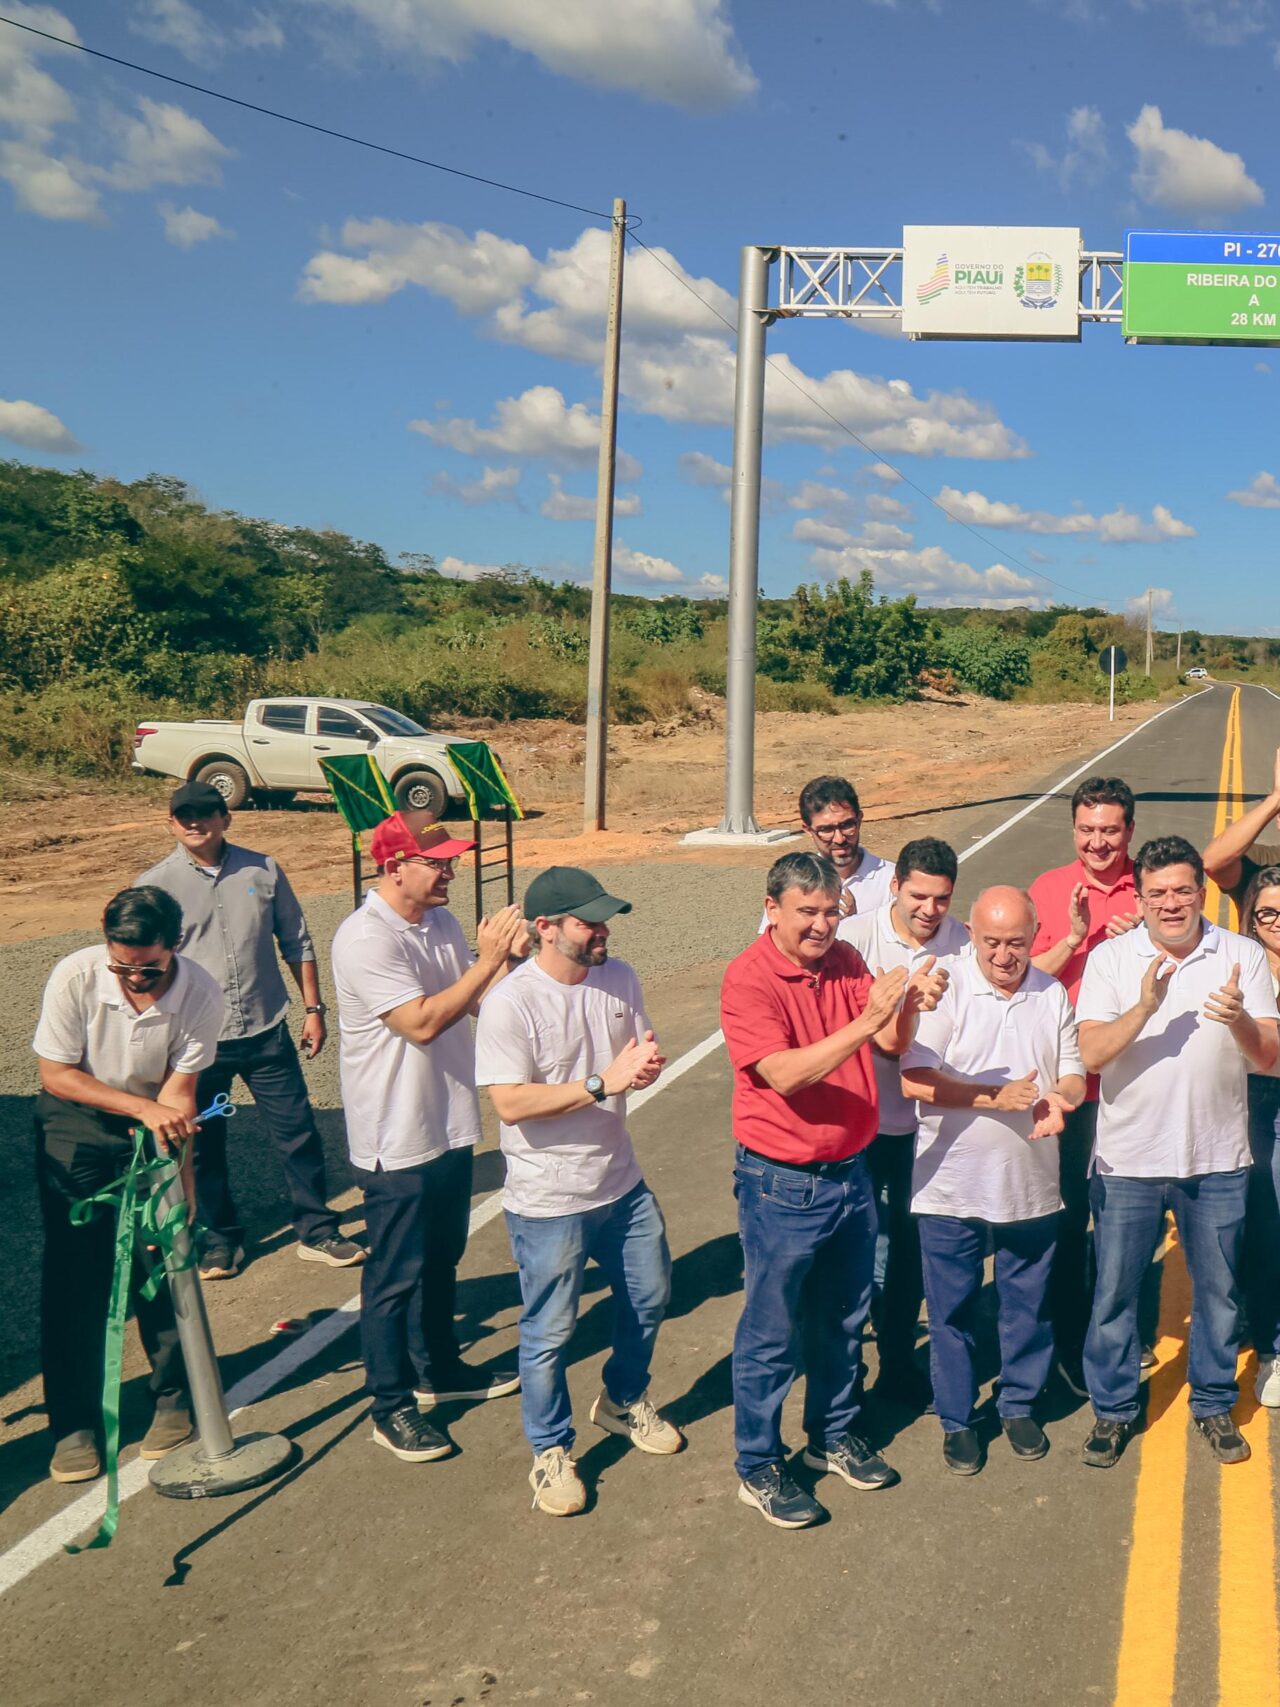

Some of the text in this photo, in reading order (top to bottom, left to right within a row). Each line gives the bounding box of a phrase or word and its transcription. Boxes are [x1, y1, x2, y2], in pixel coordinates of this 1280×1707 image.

[1224, 242, 1241, 257] PI
[1187, 273, 1249, 288] RIBEIRA
[1254, 275, 1277, 289] DO
[1248, 294, 1260, 306] A
[1231, 313, 1277, 326] 28 KM
